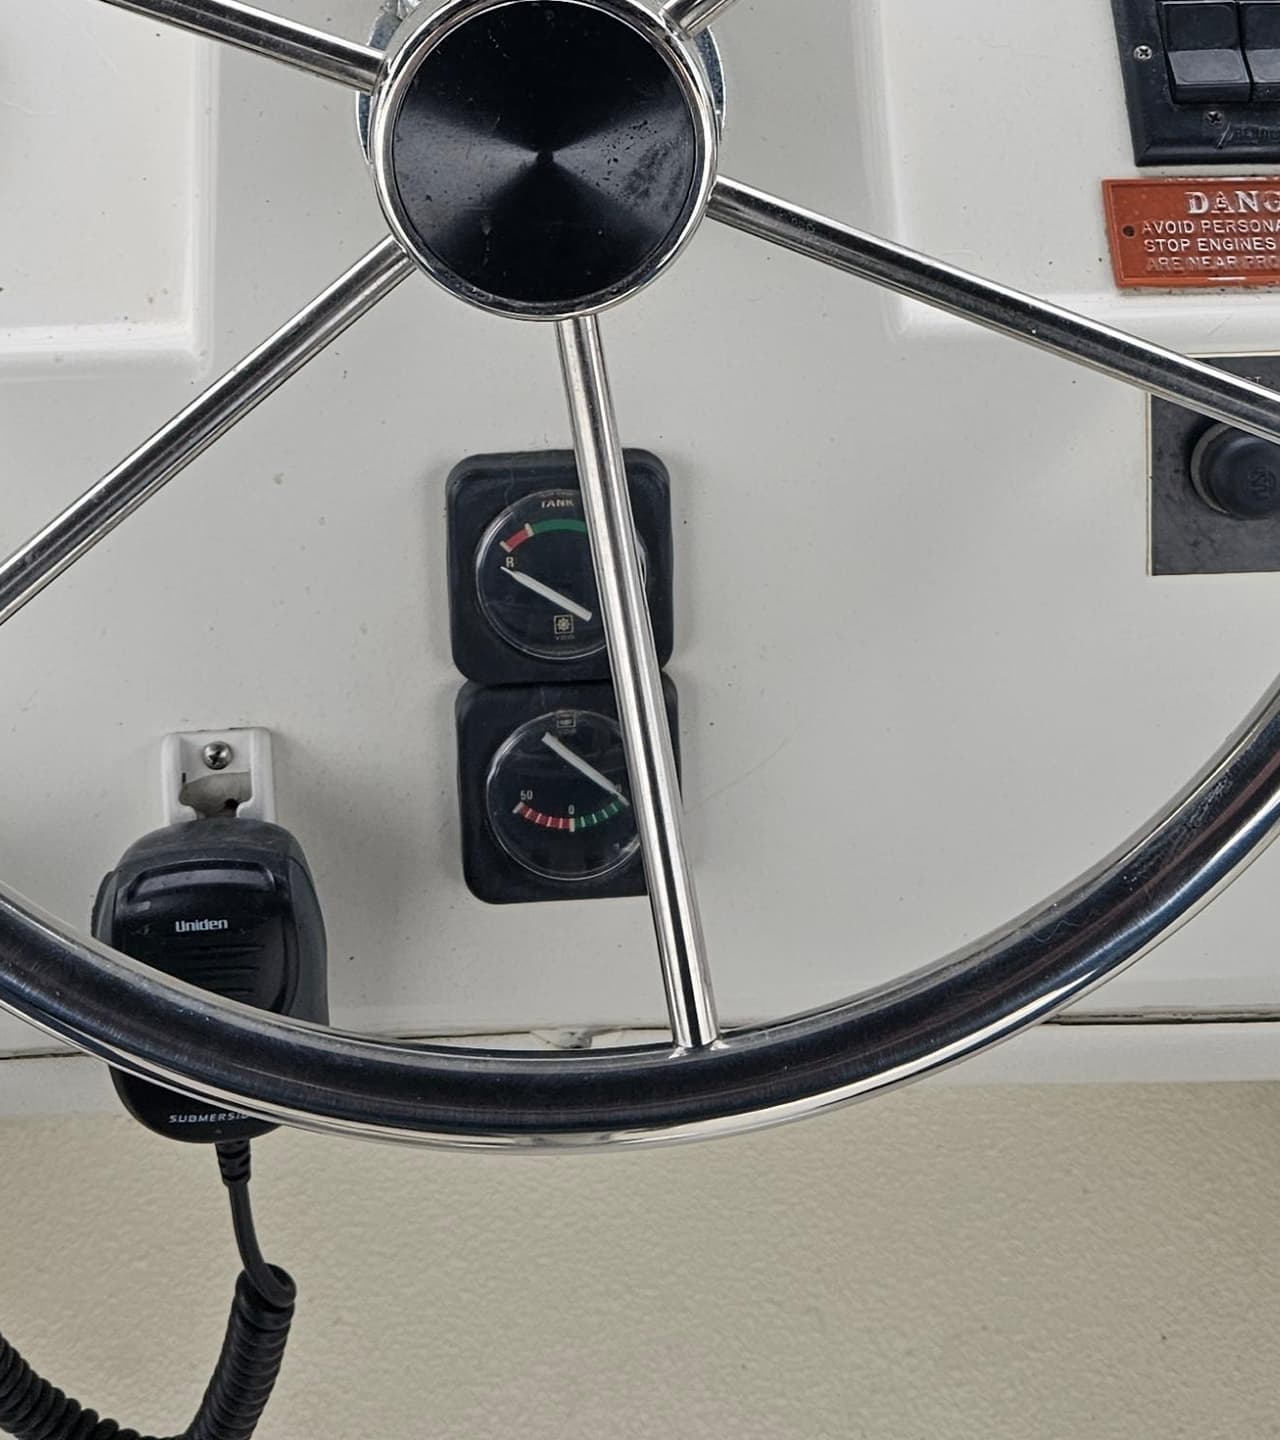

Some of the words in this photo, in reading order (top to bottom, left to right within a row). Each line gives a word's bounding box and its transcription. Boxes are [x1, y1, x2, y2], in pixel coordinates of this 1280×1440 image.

[1141, 219, 1195, 235] AVOID
[1143, 238, 1191, 253] STOP
[1197, 236, 1277, 252] ENGINES
[1146, 256, 1183, 271] ARE
[1187, 256, 1238, 270] NEAR
[541, 498, 576, 509] TANK
[505, 556, 515, 568] R
[567, 803, 576, 816] 0
[175, 917, 229, 933] Uniden
